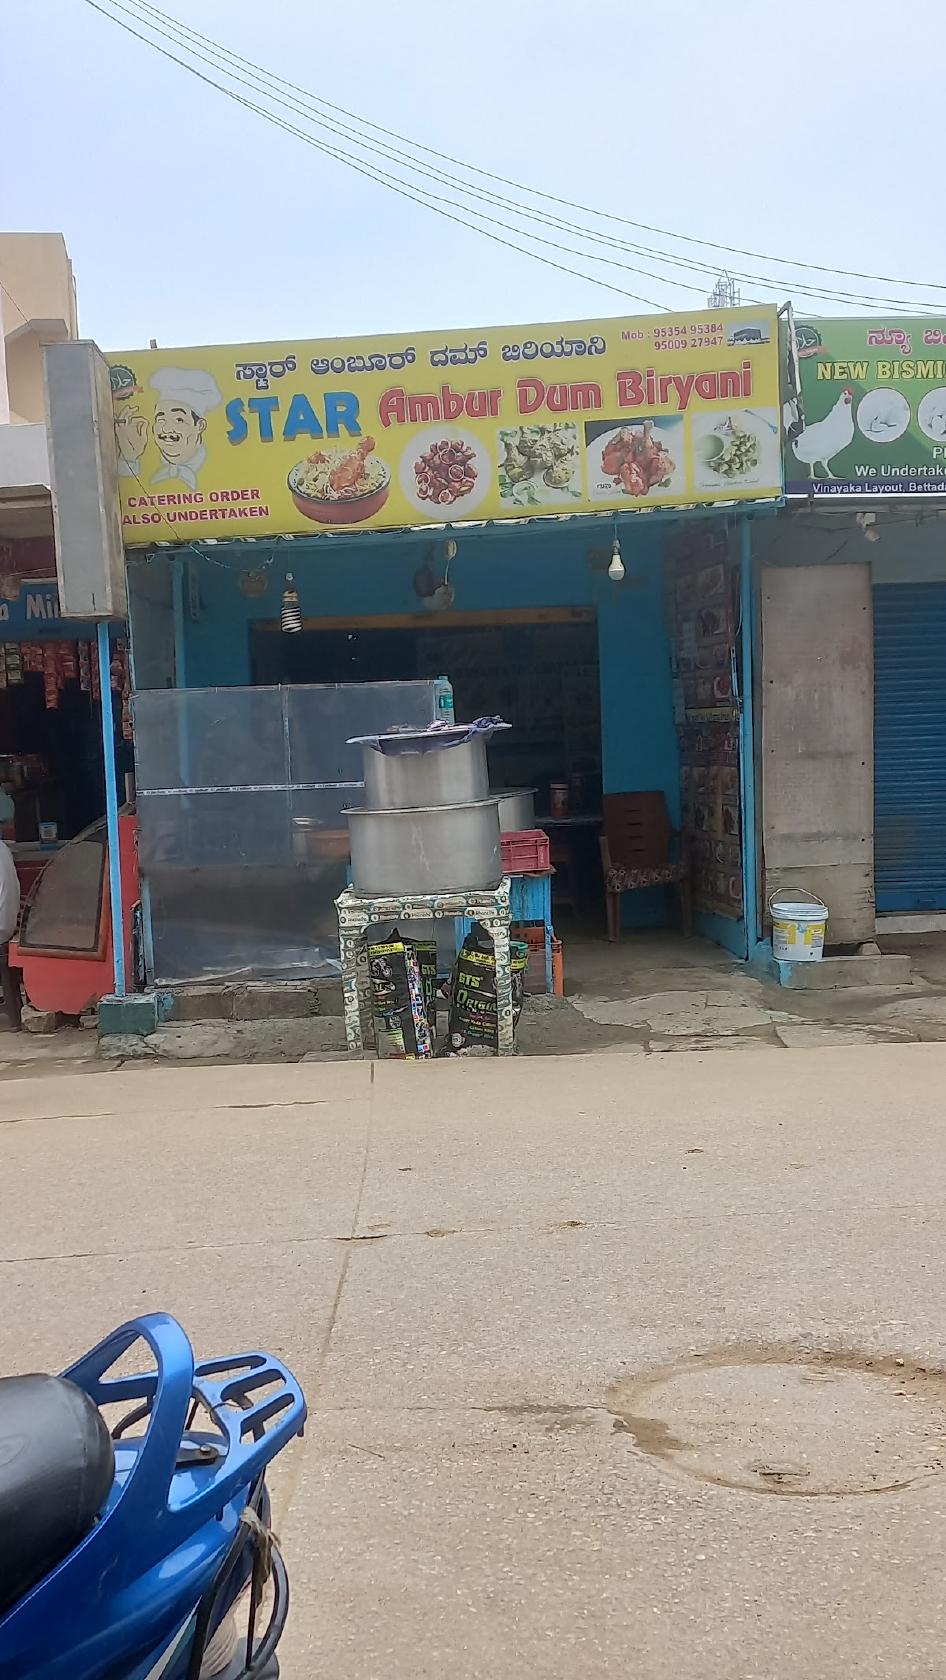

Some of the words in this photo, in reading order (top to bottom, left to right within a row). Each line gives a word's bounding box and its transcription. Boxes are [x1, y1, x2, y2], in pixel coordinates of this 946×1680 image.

[621, 330, 644, 341] Mob
[653, 326, 688, 338] 95354
[690, 322, 724, 335] 95384
[654, 339, 688, 351] 95009
[690, 336, 724, 348] 27947
[235, 354, 297, 390] ಸ್ಟಾರ್
[310, 346, 416, 375] ಆಂಬೂರ್
[429, 341, 488, 367] ದಮ್
[501, 335, 607, 362] ಬಿರಿಯಾನಿ
[817, 361, 869, 381] NEW
[877, 360, 946, 380] BISMI
[225, 391, 363, 446] STAR
[378, 384, 503, 430] Ambur
[516, 378, 603, 416] Dum
[616, 360, 753, 411] Biryani
[854, 465, 877, 477] We
[127, 491, 204, 509] CATERING
[209, 488, 261, 504] ORDER
[812, 483, 862, 494] Vinayaka
[865, 482, 906, 494] Layout,
[908, 482, 946, 493] Bettad
[122, 512, 162, 526] ALSO
[166, 505, 270, 524] UNDERTAKEN
